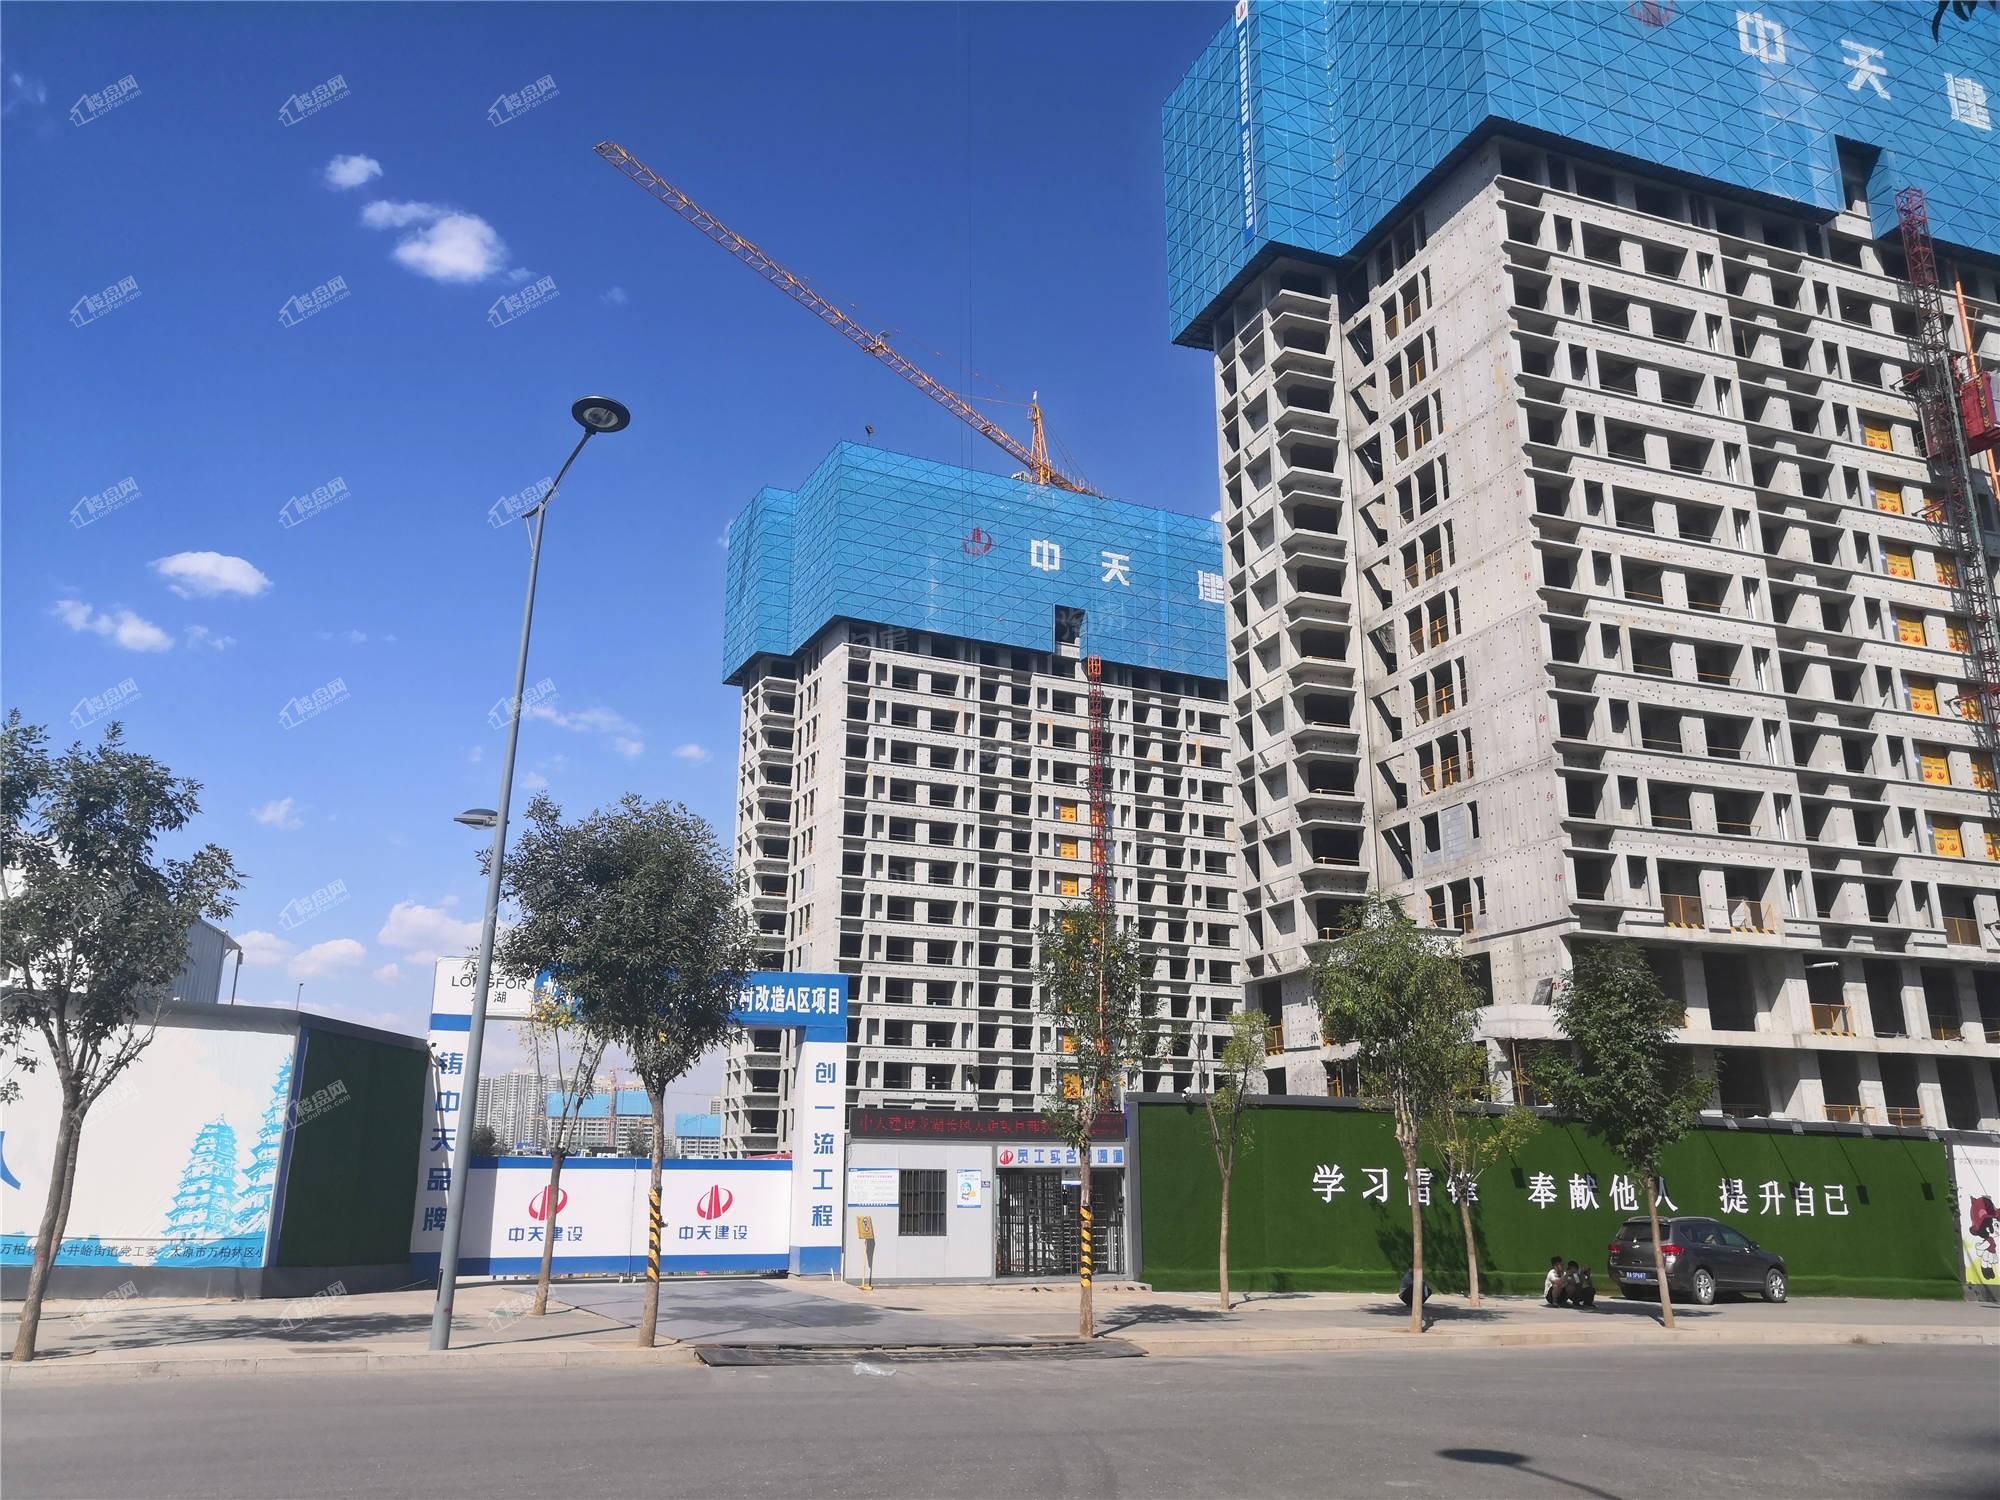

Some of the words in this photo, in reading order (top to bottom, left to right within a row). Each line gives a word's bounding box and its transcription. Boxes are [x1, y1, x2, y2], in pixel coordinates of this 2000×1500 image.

[452, 974, 528, 990] LOGFOR
[812, 1062, 837, 1227] 创一流工程
[1017, 1148, 1124, 1164] 员工实名通道
[1527, 1171, 1679, 1212] 奉献他人
[1719, 1177, 1849, 1217] 提升自己
[508, 1226, 583, 1242] 中天建设
[678, 1225, 748, 1240] 中天建设
